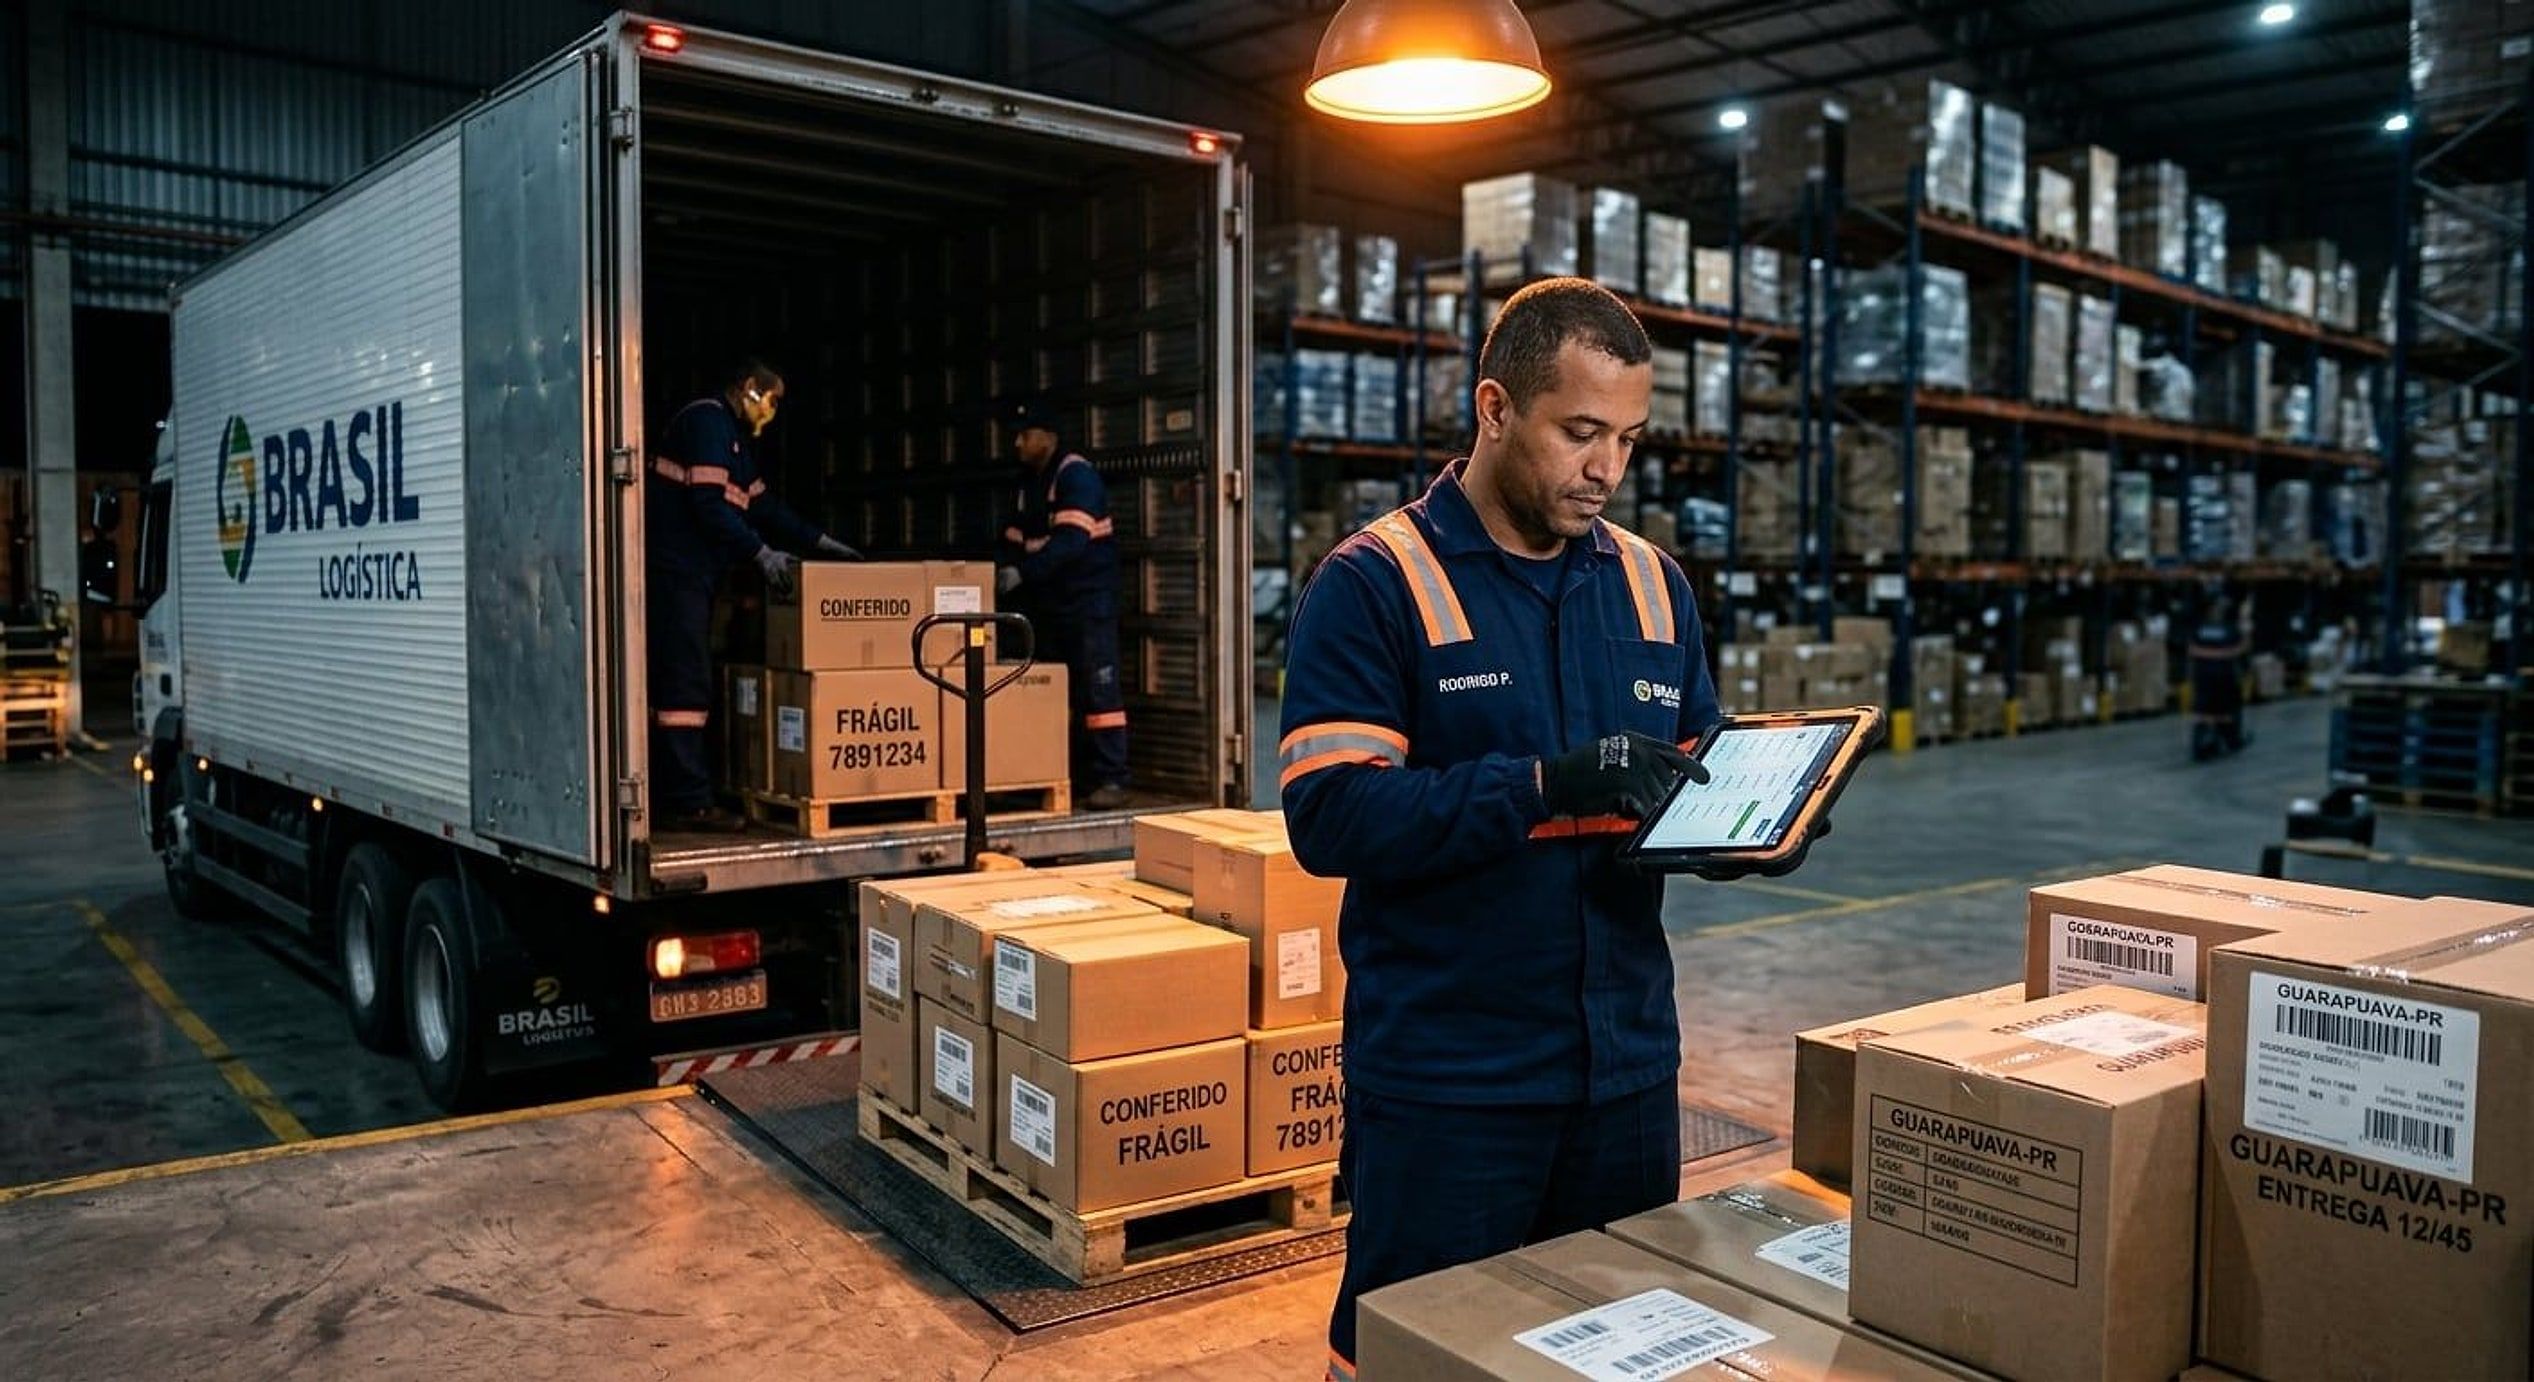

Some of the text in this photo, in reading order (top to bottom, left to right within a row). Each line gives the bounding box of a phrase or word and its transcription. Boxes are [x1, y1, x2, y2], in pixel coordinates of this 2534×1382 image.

[263, 400, 420, 534] BRASIL
[318, 541, 422, 601] LOGÍSTICA
[820, 598, 911, 617] CONFERIDO
[836, 701, 921, 735] FRÁGIL
[828, 740, 927, 771] 7891234
[498, 1002, 595, 1035] BRASIL
[2276, 983, 2444, 1029] GUARAPUAVA-PR
[1100, 1081, 1228, 1125] CONFERIDO
[1291, 1075, 1345, 1113] FRÁ
[1118, 1124, 1211, 1166] FRÁGIL
[1276, 1114, 1345, 1152] 7891
[1890, 1108, 2058, 1173] GUARAPUAVA-PR
[2229, 1133, 2507, 1226] GUARAPUAVA-PR
[2257, 1175, 2473, 1253] ENTREGA 12/45
